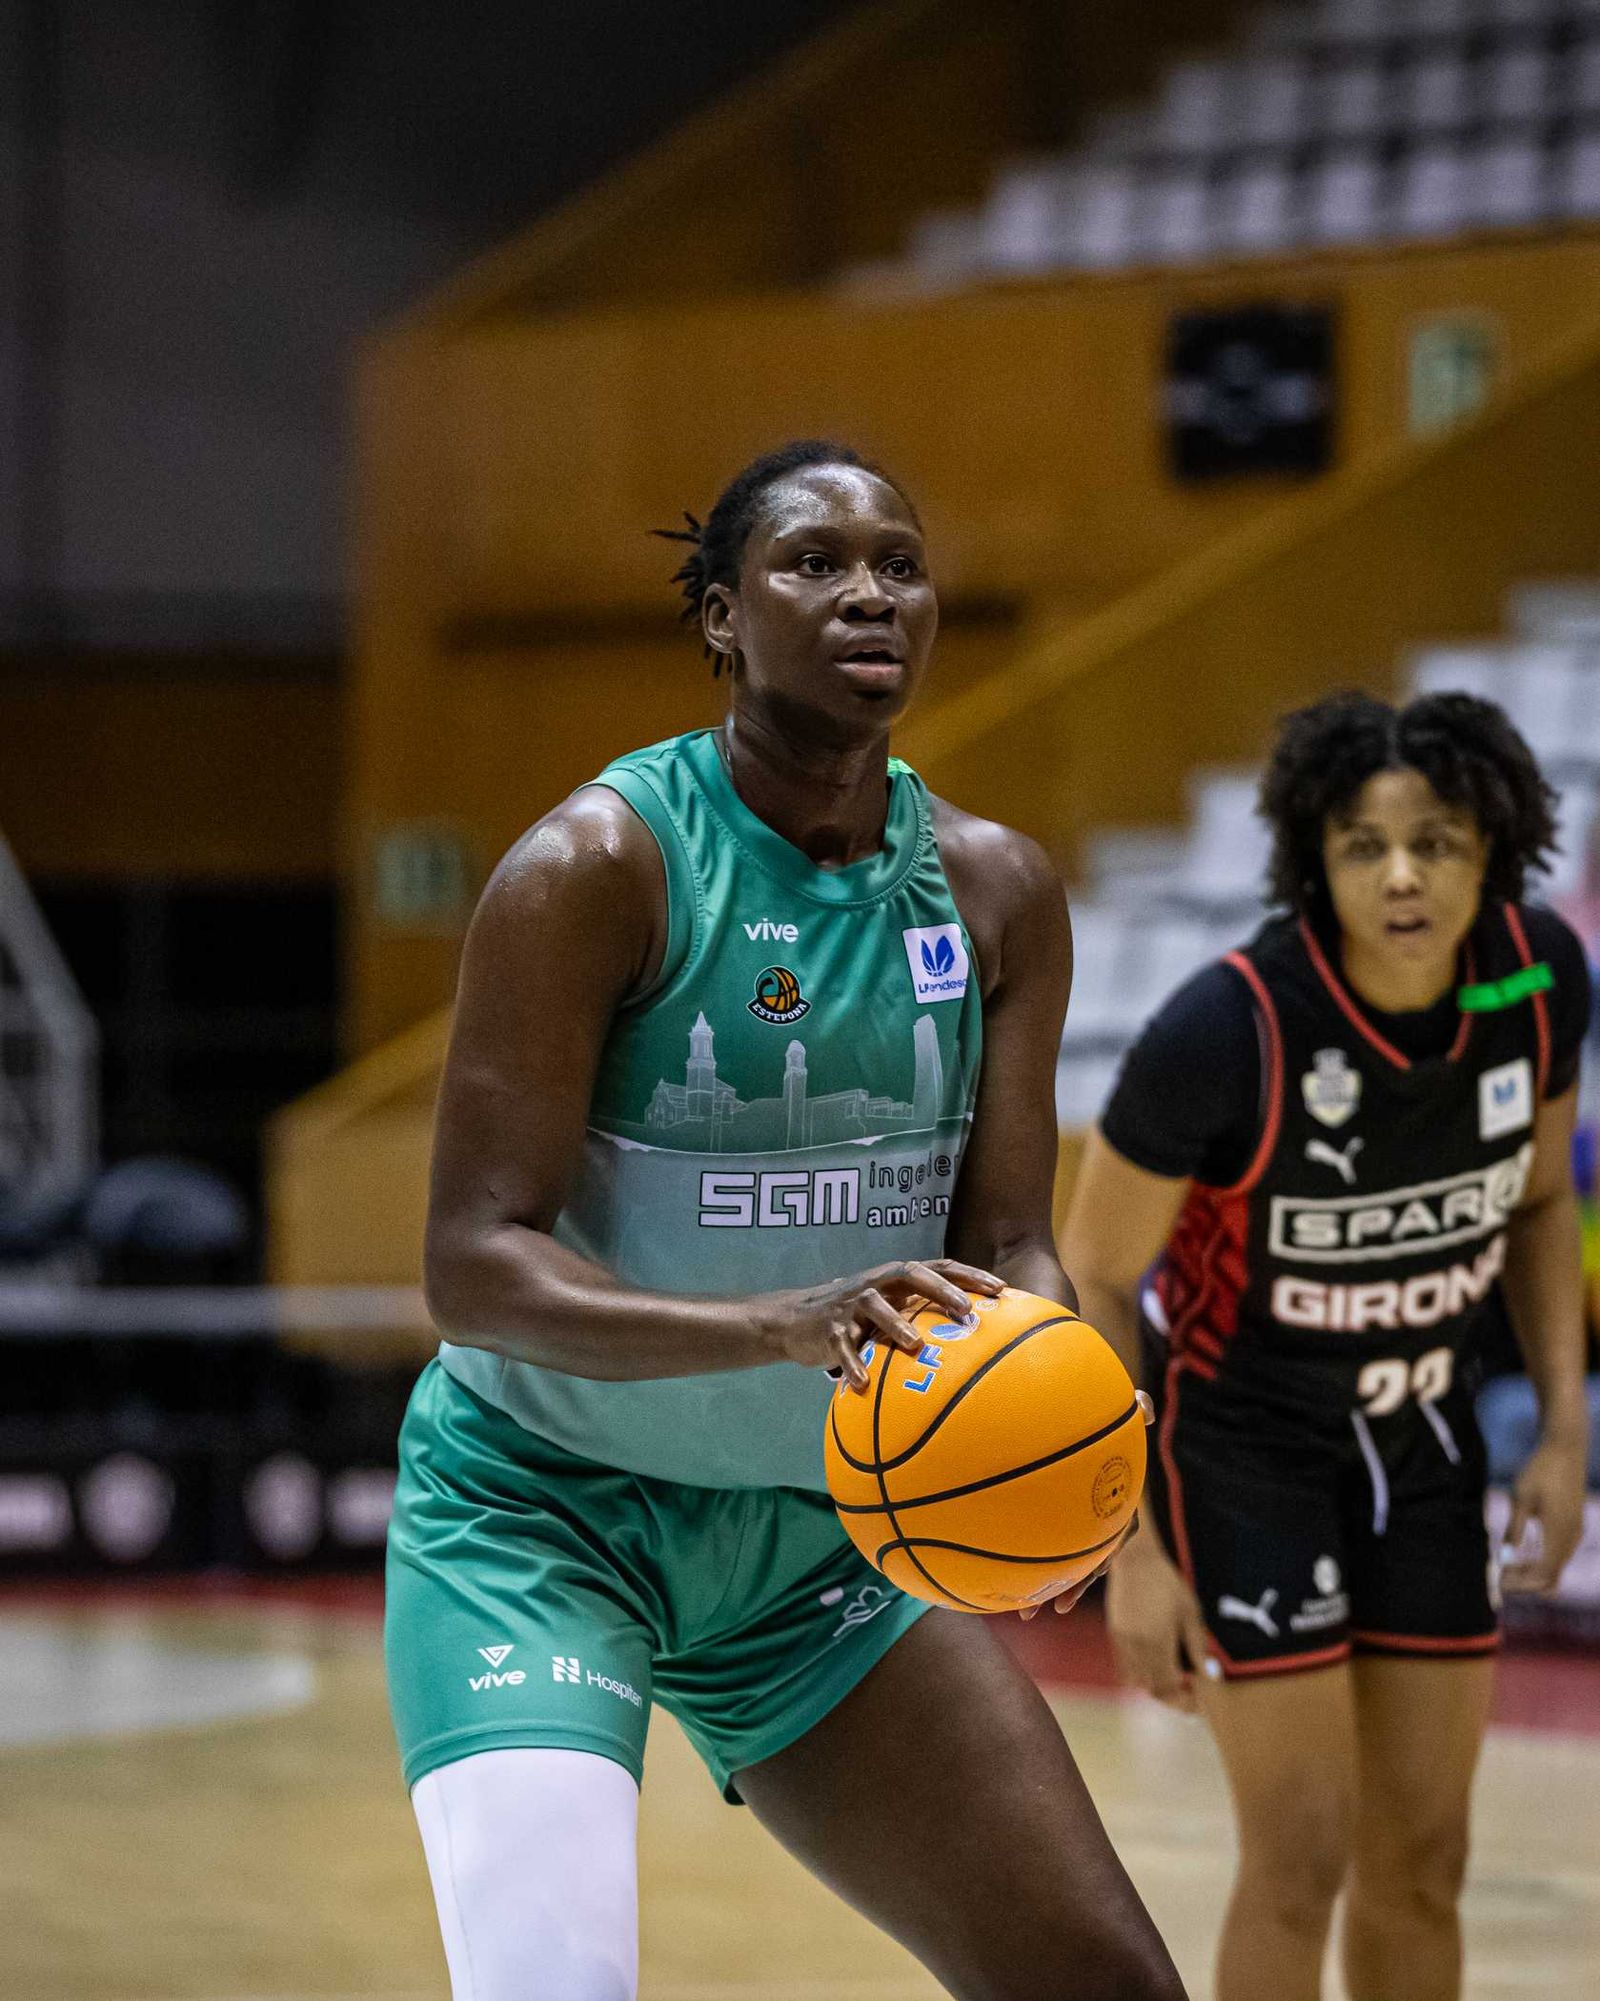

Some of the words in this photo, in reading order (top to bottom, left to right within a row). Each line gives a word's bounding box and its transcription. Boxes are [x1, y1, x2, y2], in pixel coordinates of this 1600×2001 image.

[742, 917, 799, 943] vive
[751, 1002, 807, 1022] ESTEPONA
[698, 1167, 861, 1227] SGM
[1291, 1185, 1484, 1249] SPAR
[468, 1669, 527, 1692] vive
